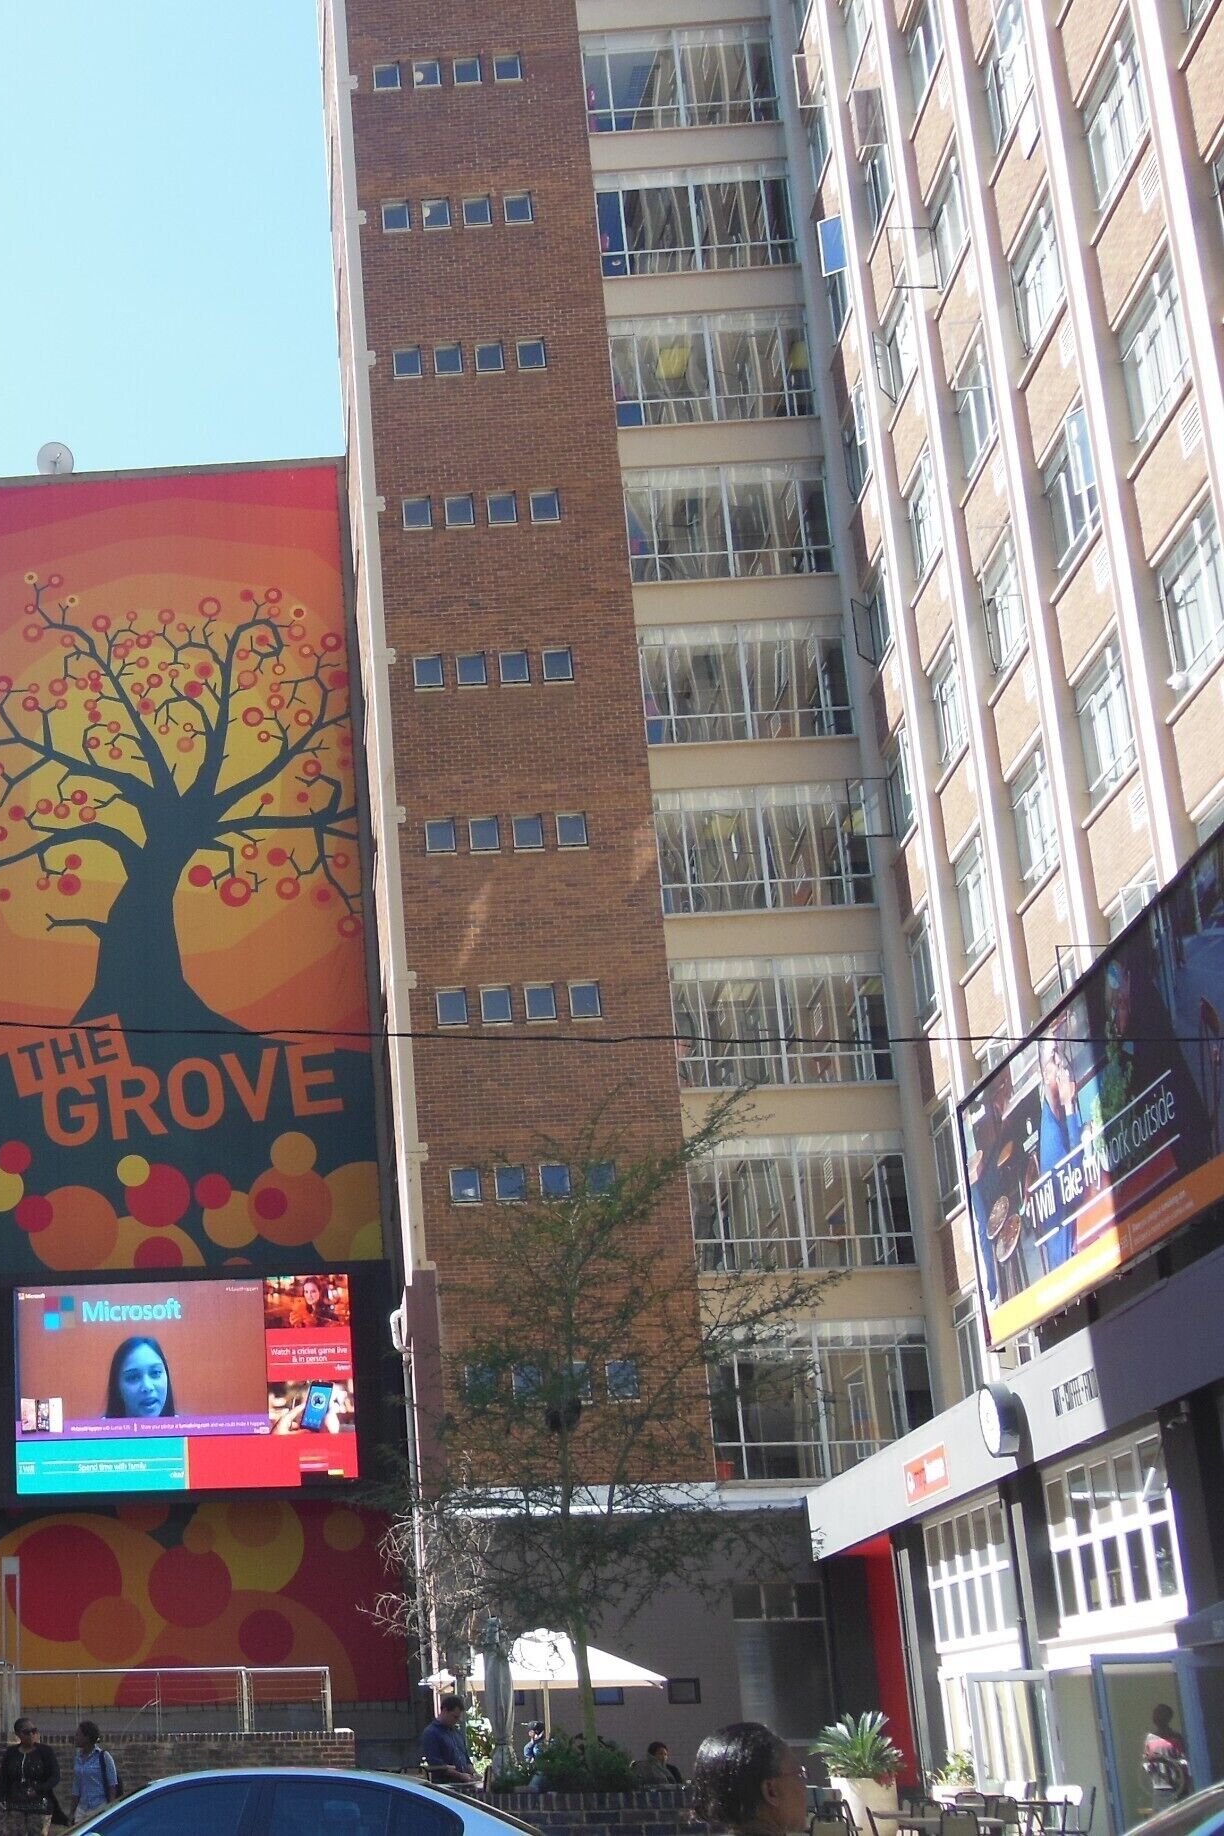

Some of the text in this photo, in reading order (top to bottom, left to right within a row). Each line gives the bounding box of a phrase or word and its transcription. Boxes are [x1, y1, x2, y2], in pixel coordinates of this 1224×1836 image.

[17, 1023, 121, 1081] THE
[41, 1040, 344, 1147] GROVE
[1035, 1178, 1056, 1223] Will
[1057, 1163, 1084, 1206] Take
[1082, 1150, 1101, 1191] my
[1132, 1084, 1175, 1148] outside
[82, 1297, 182, 1322] Microsoft
[271, 1348, 291, 1356] Watch
[297, 1347, 317, 1355] cricket
[318, 1348, 336, 1356] game
[337, 1346, 348, 1354] live
[78, 1463, 98, 1472] Spend
[99, 1463, 112, 1472] time
[113, 1462, 127, 1471] with
